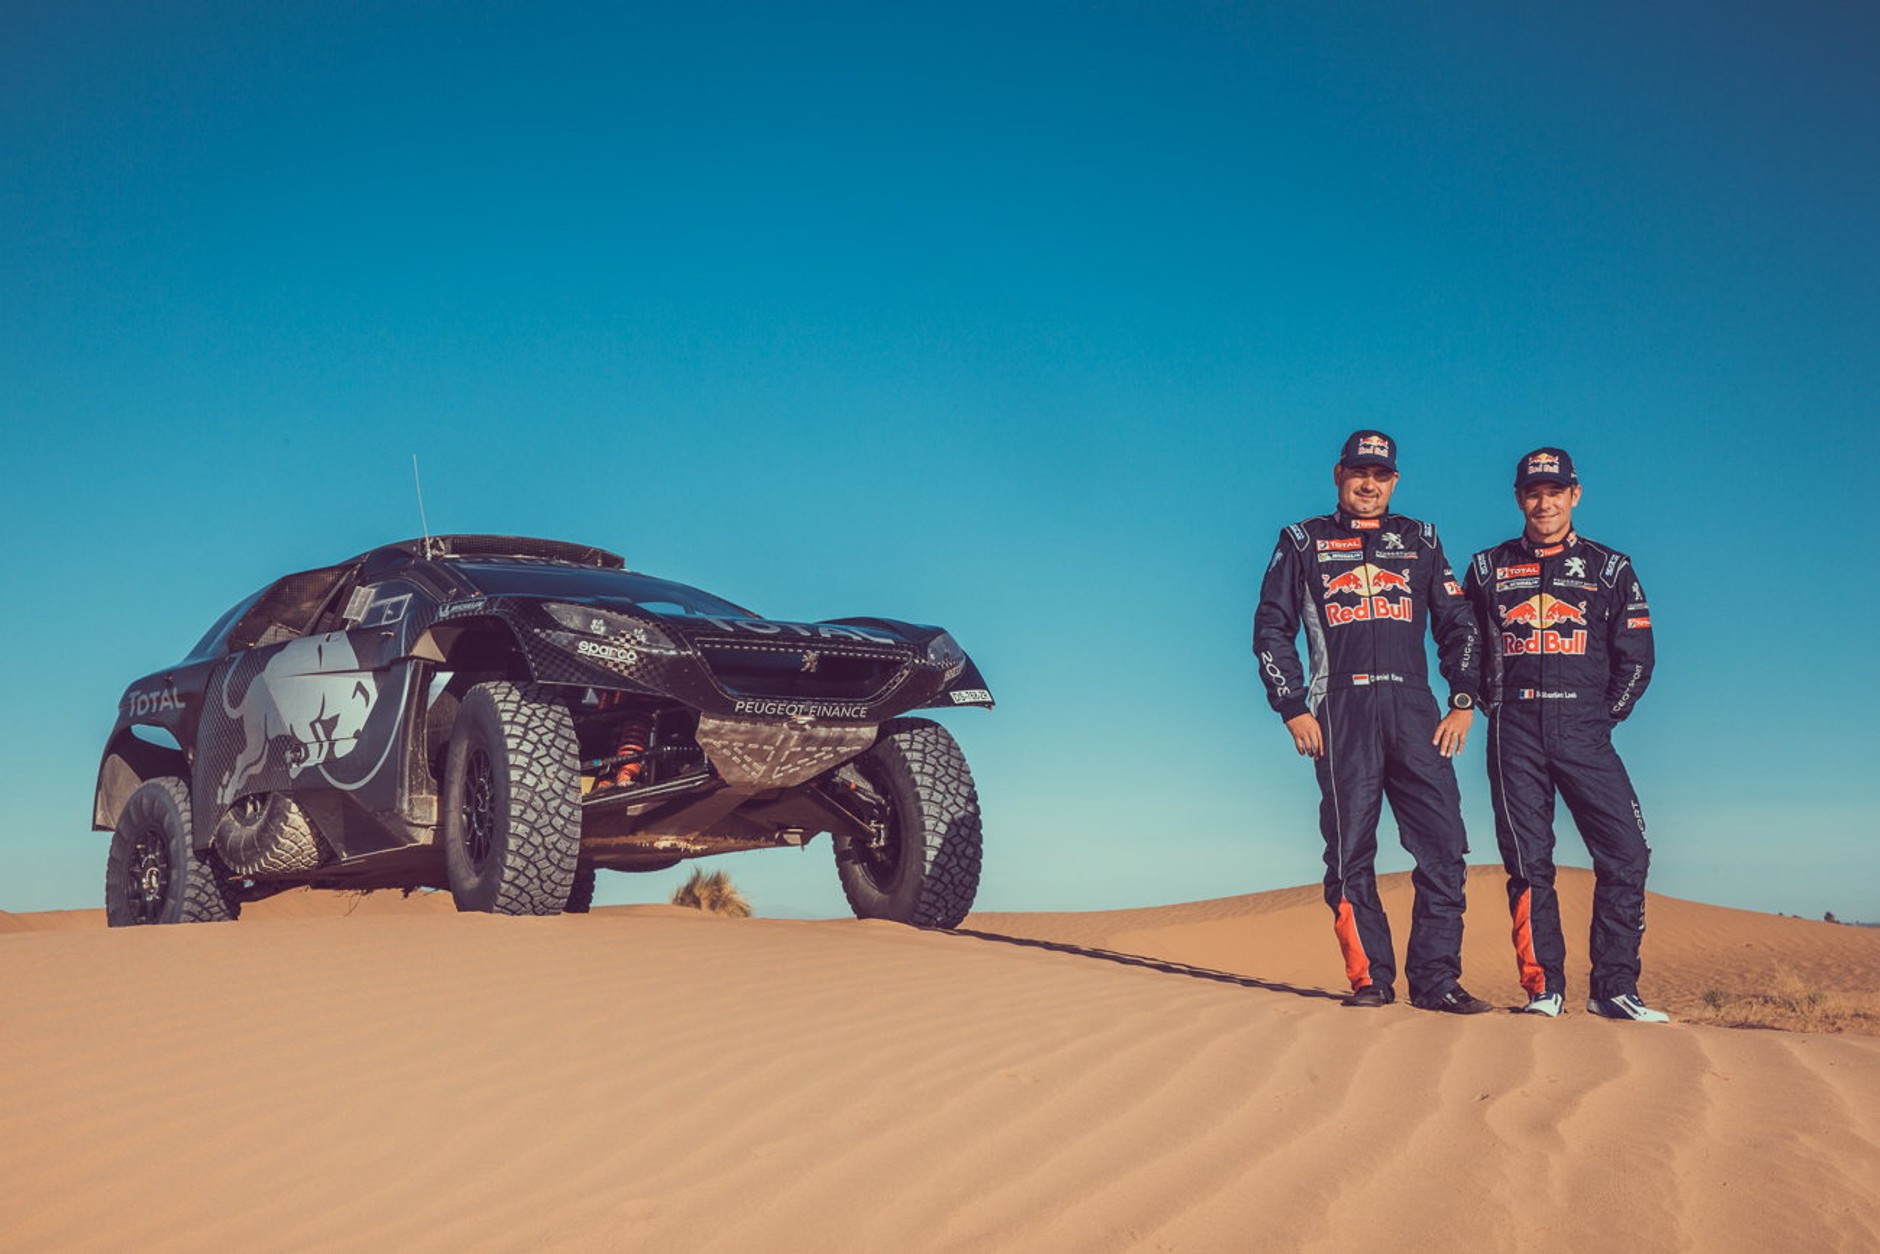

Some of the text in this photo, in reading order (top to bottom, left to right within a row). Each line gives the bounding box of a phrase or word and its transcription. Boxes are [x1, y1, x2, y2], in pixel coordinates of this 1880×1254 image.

[1330, 540, 1360, 548] TOTAL
[1510, 567, 1538, 576] TOTAL
[1325, 596, 1413, 627] Red Bull
[579, 640, 638, 661] sparco
[1502, 629, 1587, 656] Red Bull
[129, 687, 187, 718] TOTAL
[734, 701, 869, 719] PEUGEOT FINANCE
